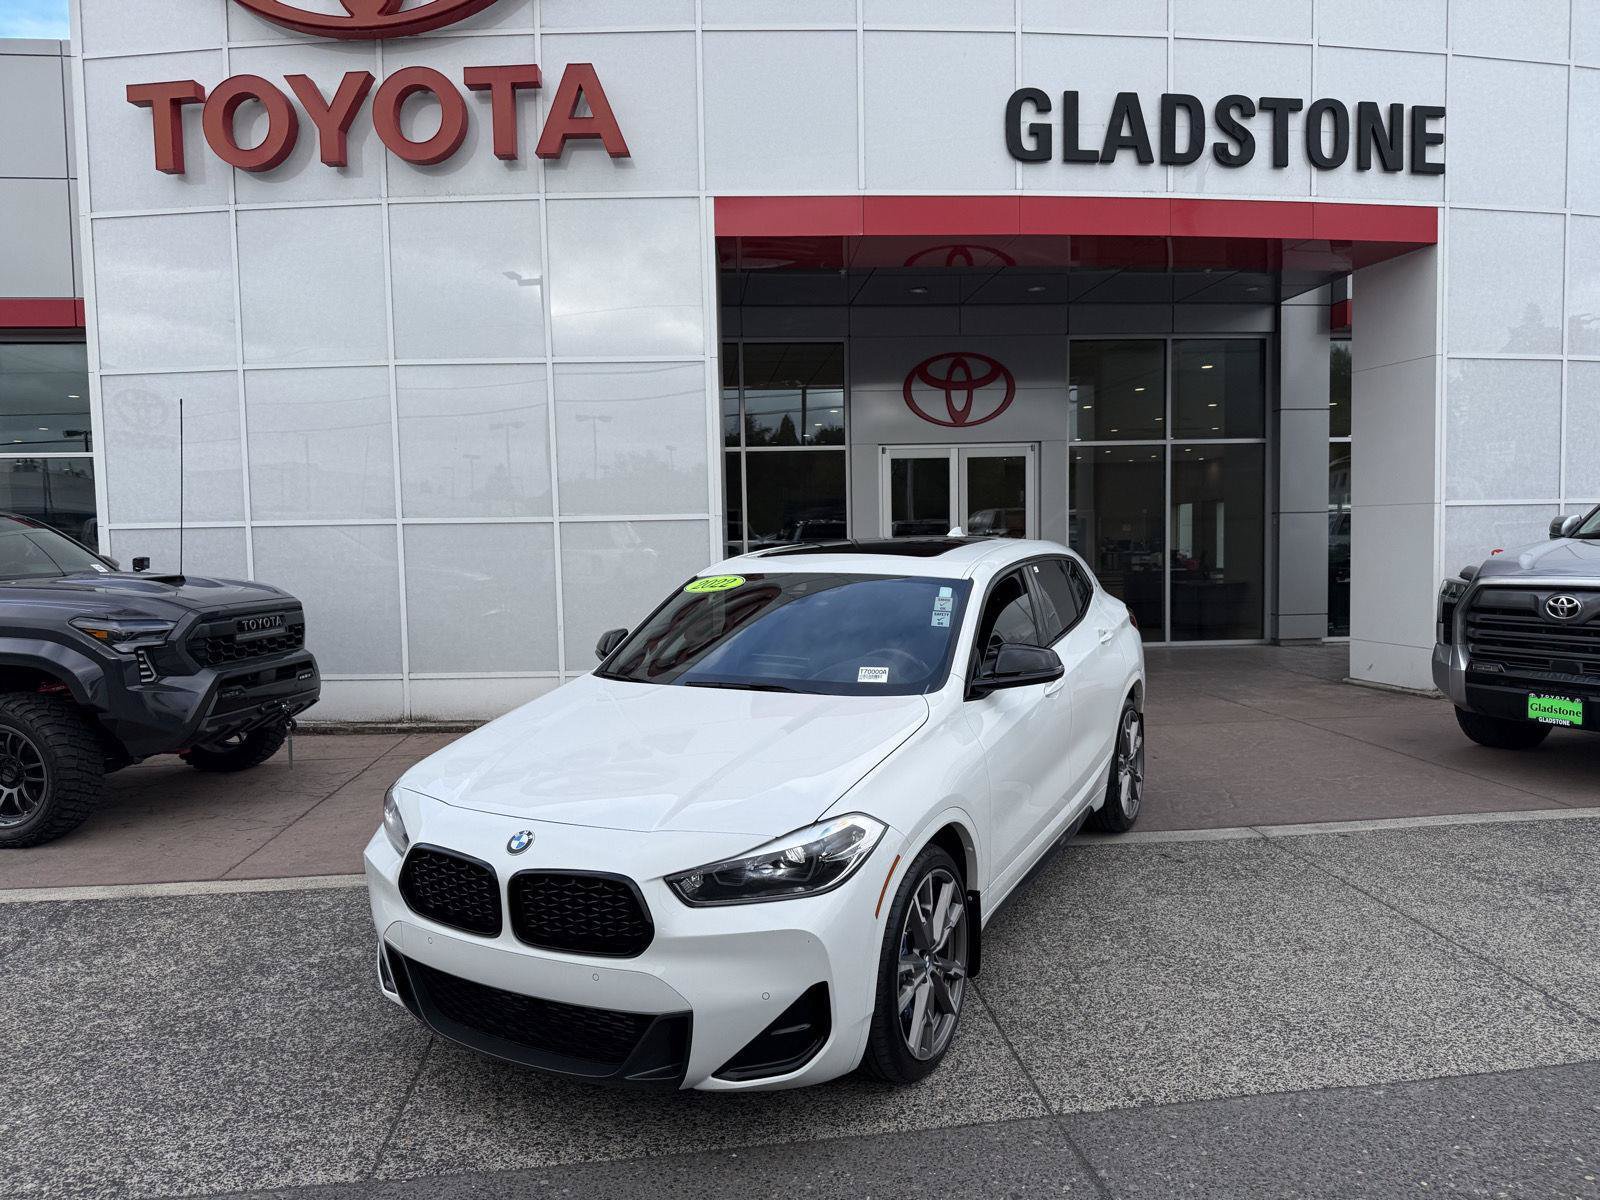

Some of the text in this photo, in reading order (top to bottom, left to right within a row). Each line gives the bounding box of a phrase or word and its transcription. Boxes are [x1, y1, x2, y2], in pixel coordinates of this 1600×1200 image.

[126, 63, 630, 174] TOYOTA
[1005, 87, 1445, 175] GLADSTONE
[690, 578, 738, 590] 2022
[241, 616, 283, 630] TOYOTA
[1530, 702, 1582, 718] Gladstone
[1538, 716, 1571, 726] GLADSTONE
